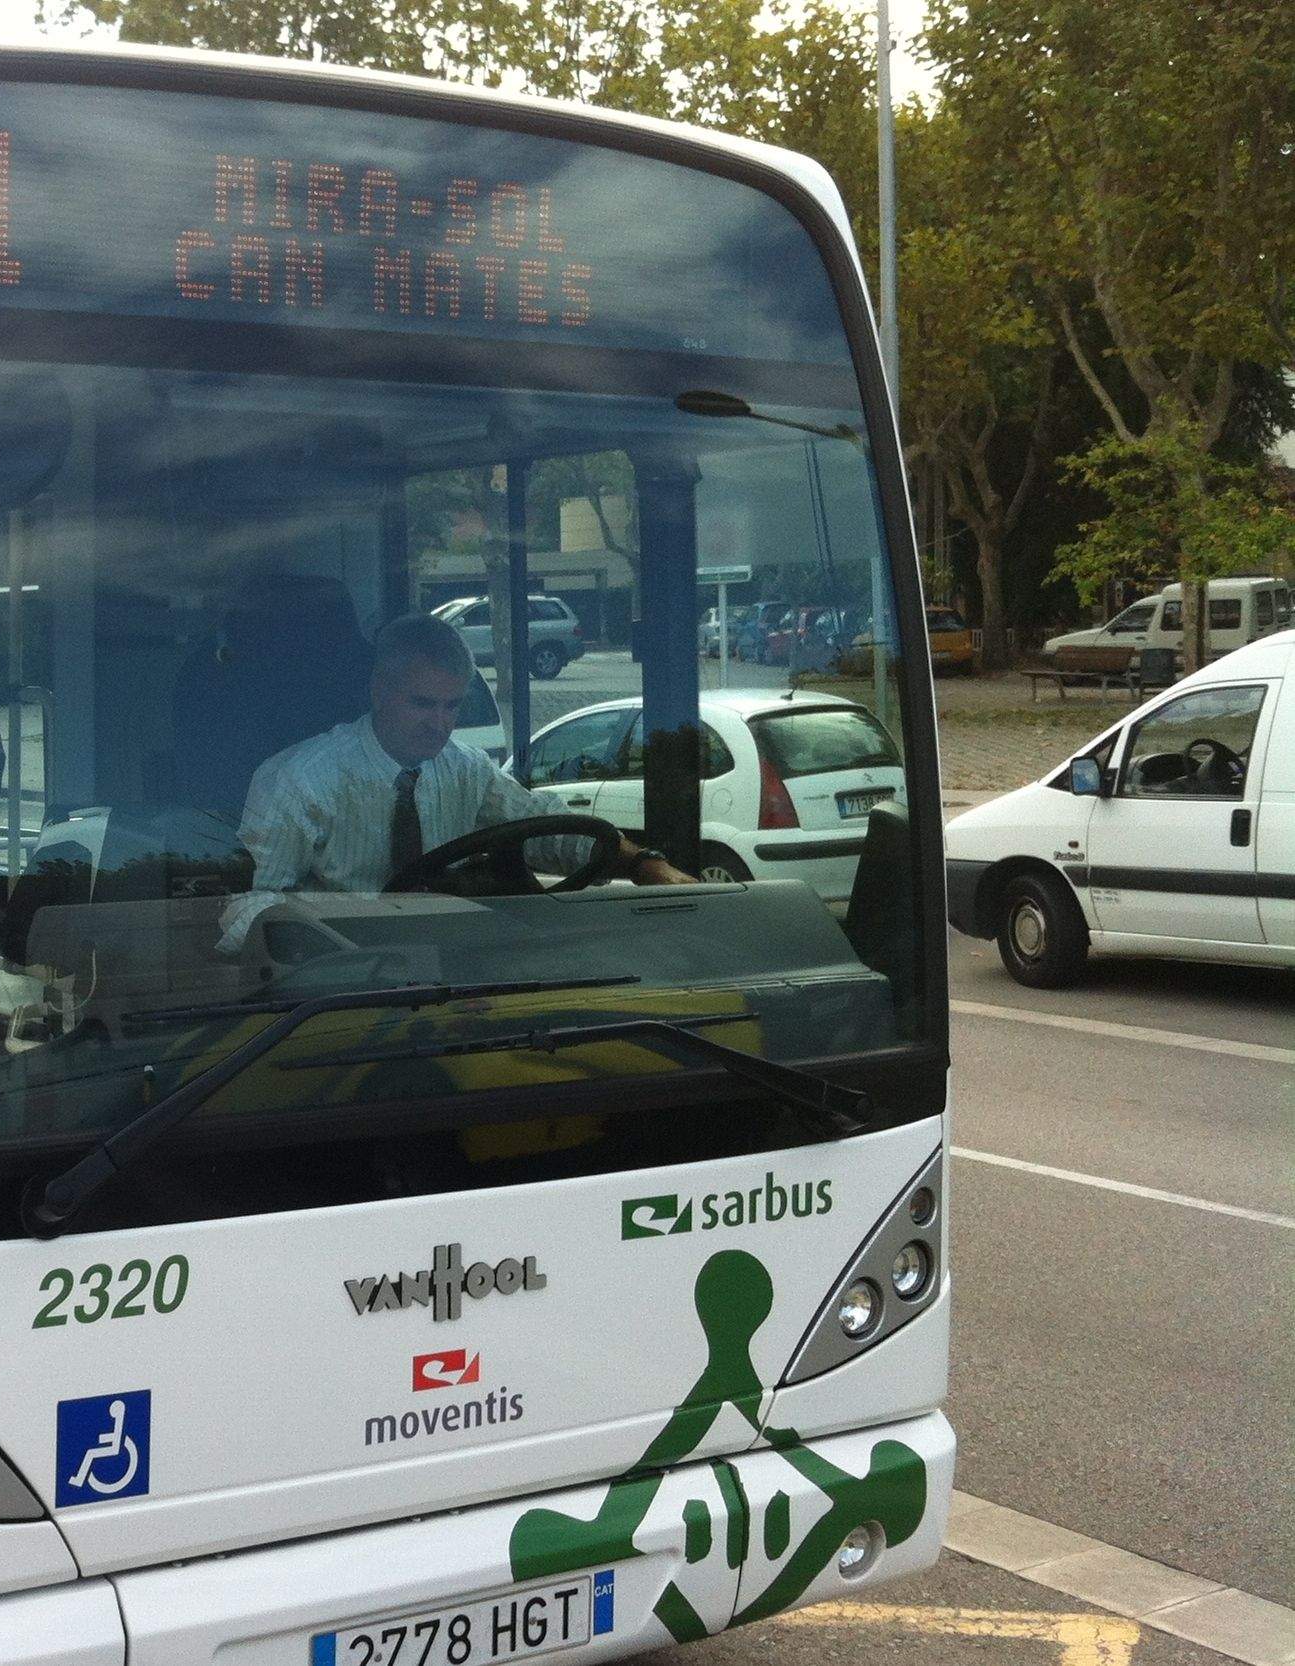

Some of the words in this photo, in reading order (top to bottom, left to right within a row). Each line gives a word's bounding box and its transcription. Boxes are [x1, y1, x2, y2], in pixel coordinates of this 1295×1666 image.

[215, 152, 565, 253] MIRA-SOL
[175, 230, 324, 306] CAN
[373, 245, 593, 327] MATES
[700, 1171, 833, 1230] sarbus
[31, 1254, 190, 1329] 2320
[365, 1386, 524, 1446] moventis
[348, 1613, 472, 1666] 2778
[491, 1587, 579, 1657] HGT
[595, 1582, 615, 1598] CAT
